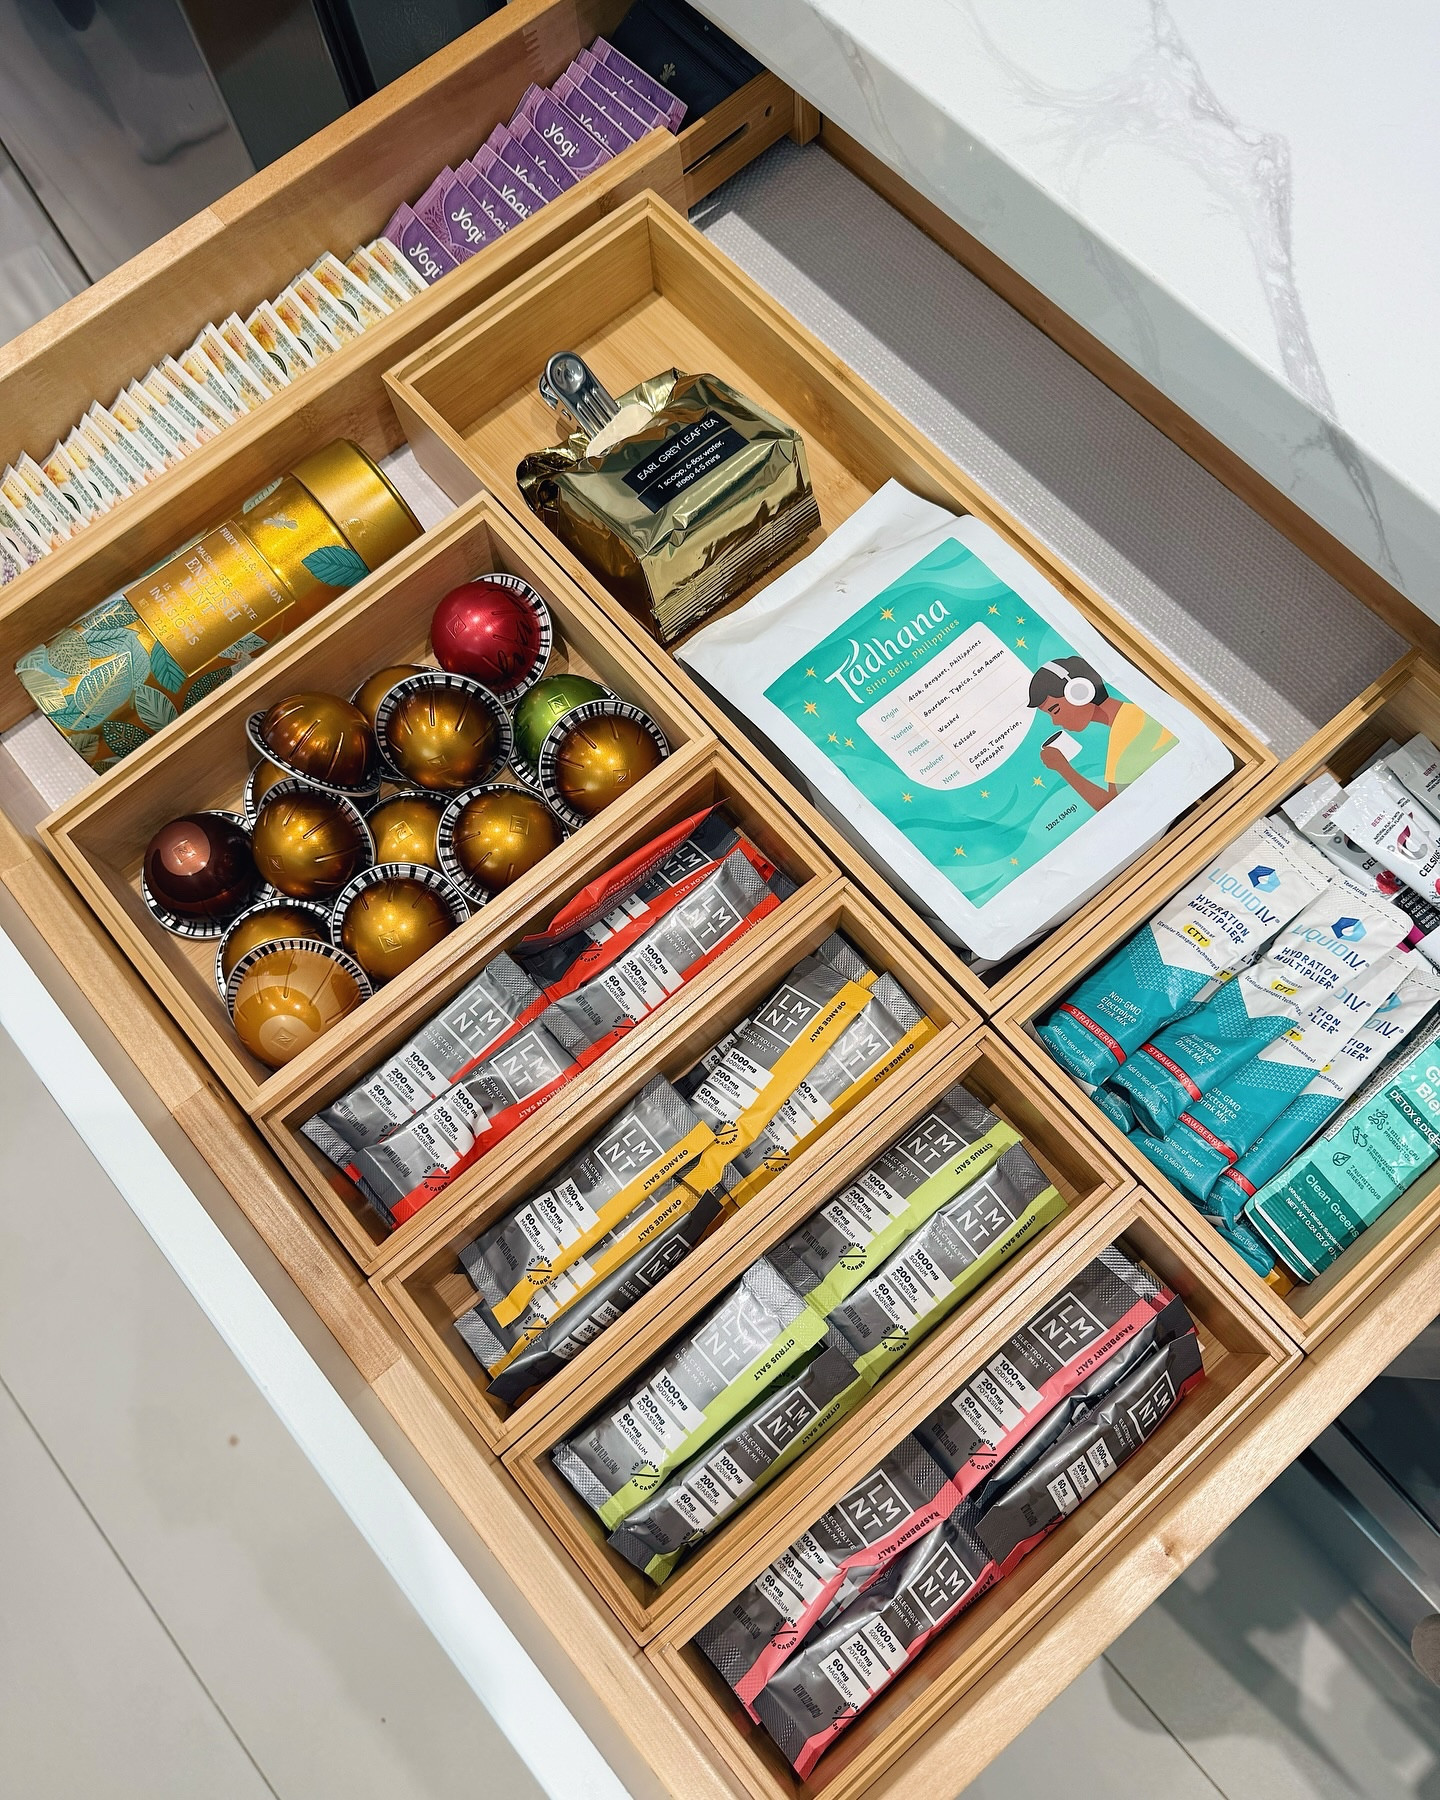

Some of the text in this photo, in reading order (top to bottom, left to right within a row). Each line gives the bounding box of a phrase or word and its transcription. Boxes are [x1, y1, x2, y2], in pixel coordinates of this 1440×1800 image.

[637, 418, 719, 481] EARL GREY LEAF TEA
[676, 454, 721, 489] steep 4-5 mins
[180, 577, 216, 615] MINT
[185, 557, 242, 622] ENGLISH
[231, 589, 258, 620] ESTATE
[150, 587, 200, 645] INFUSIONS
[824, 600, 951, 704] Tadhana
[866, 677, 888, 695] Sitio
[912, 620, 960, 659] Philippines
[949, 640, 982, 668] Philippines
[972, 664, 985, 677] San
[880, 707, 899, 723] Origin
[938, 714, 960, 733] Washed
[891, 722, 914, 742] Varietal
[907, 738, 930, 757] Process
[953, 729, 977, 749] Kalsada
[919, 754, 945, 775] Producer
[975, 744, 1005, 770] Pineapple
[942, 769, 960, 785] Notes
[1045, 804, 1078, 831] 12oz (340g)
[1196, 894, 1250, 937] HYDRATION
[1281, 947, 1340, 982] HYDRATION
[1097, 1004, 1128, 1027] Drink Mix
[1101, 997, 1137, 1023] Electrolyte
[1109, 992, 1142, 1015] Non-GMO
[809, 1001, 847, 1043] ORANGE SALT
[1070, 1008, 1118, 1049] STRAWBERRY
[423, 1031, 451, 1060] DRINK MIX
[429, 1026, 464, 1063] ELECTROLYTE
[1175, 1040, 1205, 1066] Drink Mix
[1181, 1036, 1215, 1063] Electrolyte
[404, 1057, 424, 1078] SODIUM
[874, 1043, 914, 1082] ORANGE SALT
[1148, 1047, 1193, 1088] STRAWBERRY
[386, 1073, 415, 1102] POTASSIUM
[367, 1088, 398, 1120] MAGNESIUM
[1390, 1089, 1415, 1118] DETOX
[643, 1149, 689, 1190] ORANGE SALT
[954, 1142, 993, 1175] CITRUS SALT
[1346, 1170, 1364, 1190] GREENS
[1286, 1197, 1297, 1210] NET
[1288, 1186, 1313, 1215] Whole Food
[1305, 1174, 1359, 1237] Clean Greens
[1000, 1215, 1036, 1255] CITRUS SALT
[753, 1338, 795, 1381] CITRUS SALT
[1011, 1339, 1041, 1369] DRINK MIX
[1017, 1334, 1055, 1373] ELECTROLYTE
[1076, 1324, 1134, 1377] RASPBERRY SALT
[994, 1365, 1014, 1387] SODIUM
[655, 1383, 676, 1408] SODIUM
[976, 1385, 1004, 1414] POTASSIUM
[637, 1401, 665, 1437] POTASSIUM
[959, 1402, 987, 1435] MAGNESIUM
[617, 1419, 648, 1456] MAGNESIUM
[877, 1511, 940, 1560] RASPBERRY SALT
[846, 1646, 872, 1677] POTASSIUM
[826, 1664, 853, 1698] MAGNESIUM
